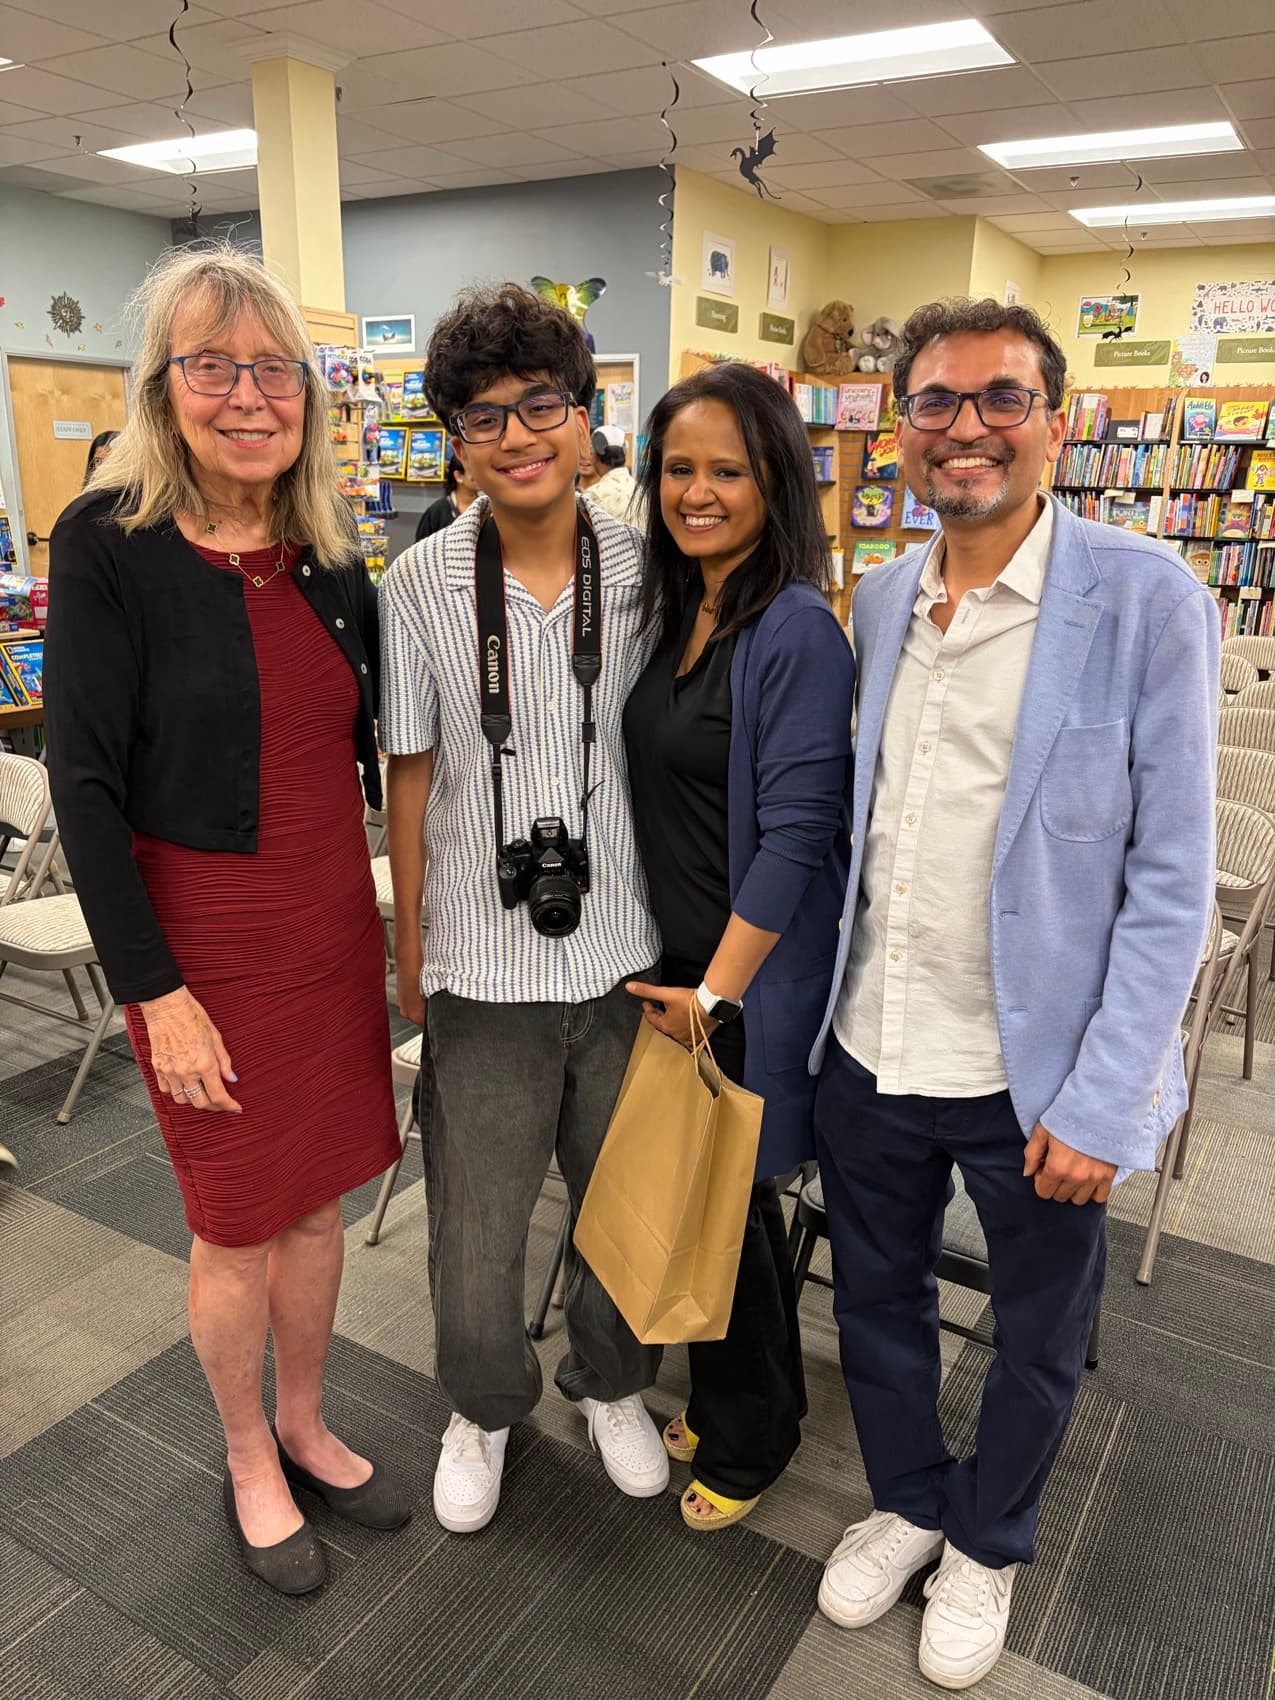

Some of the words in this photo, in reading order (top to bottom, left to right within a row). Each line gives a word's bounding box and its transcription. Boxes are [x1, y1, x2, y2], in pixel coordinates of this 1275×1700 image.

[1213, 300, 1255, 314] HELLO
[1113, 350, 1133, 358] Picture
[1133, 348, 1151, 357] Books
[1236, 346, 1258, 355] Picture
[904, 510, 935, 526] EVER
[580, 535, 592, 569] EOS
[580, 574, 592, 638] DIGITAL
[486, 634, 501, 695] Canon
